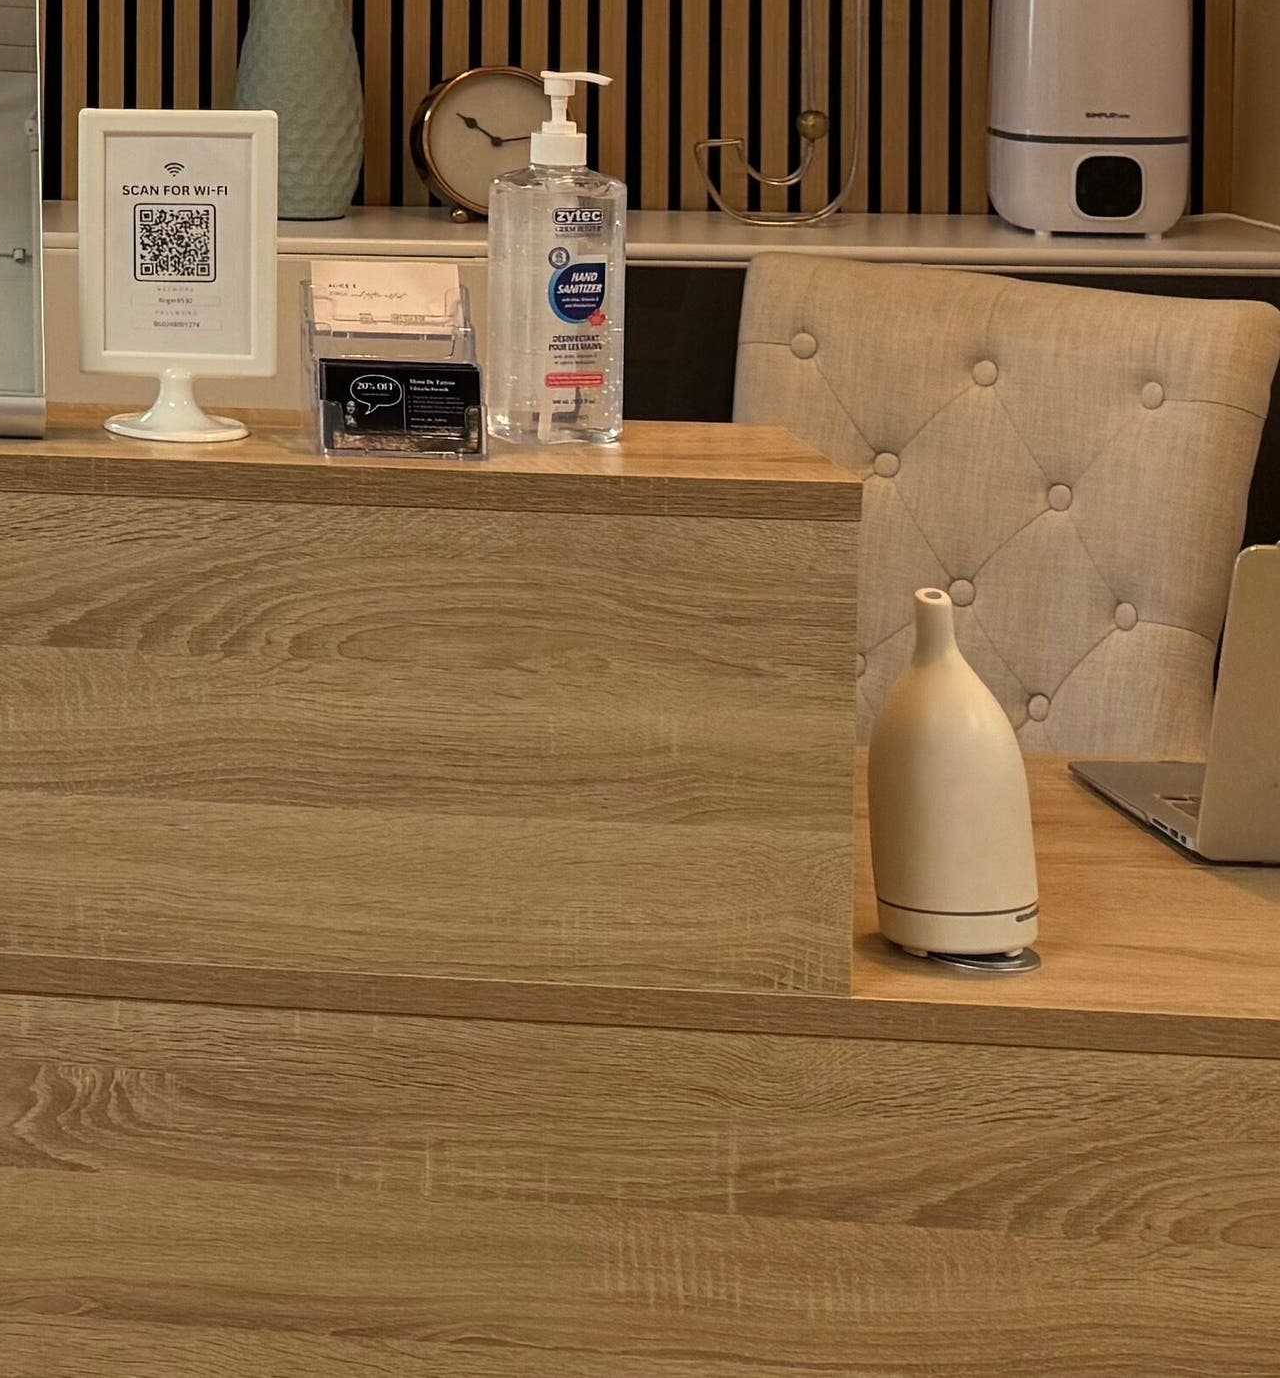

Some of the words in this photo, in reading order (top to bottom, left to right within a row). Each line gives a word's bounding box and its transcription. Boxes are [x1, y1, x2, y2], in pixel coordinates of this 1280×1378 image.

[122, 185, 159, 196] SCAN
[163, 185, 190, 196] FOR
[194, 185, 228, 196] WI-FI
[556, 210, 601, 224] zytec
[571, 272, 598, 282] HAND
[556, 283, 603, 294] SANITIZER
